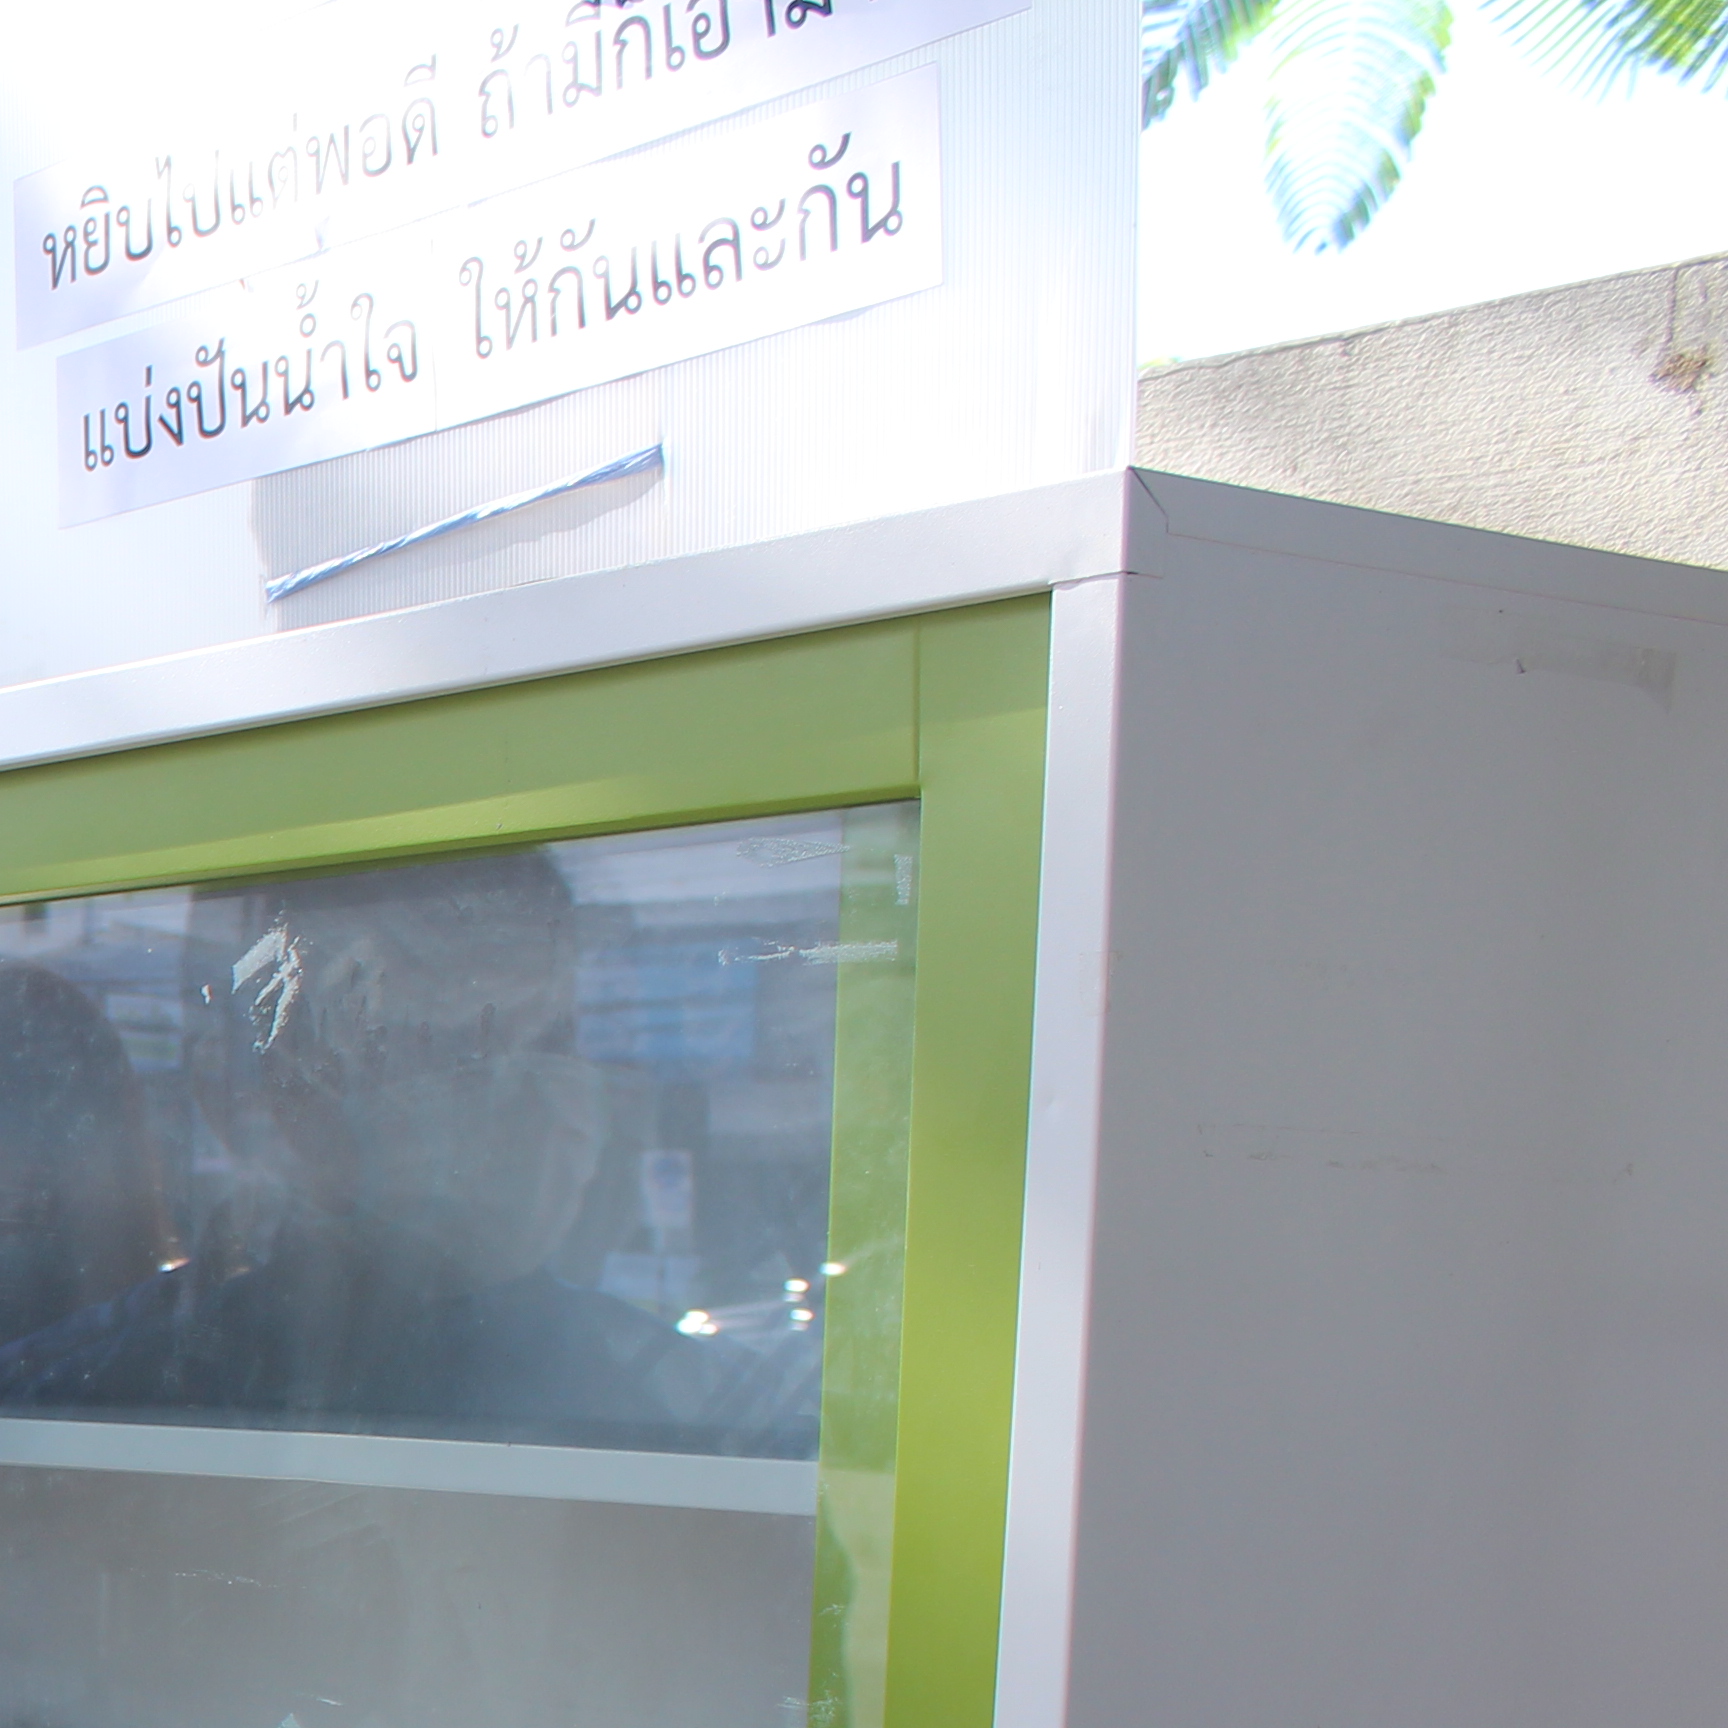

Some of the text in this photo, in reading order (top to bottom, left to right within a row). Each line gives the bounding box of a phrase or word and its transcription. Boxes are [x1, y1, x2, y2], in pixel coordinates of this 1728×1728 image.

[42, 55, 438, 290] หยิบไปแต่พอดี
[82, 131, 904, 473] แบ่งปันน้ำใจ ให้กันและกัน
